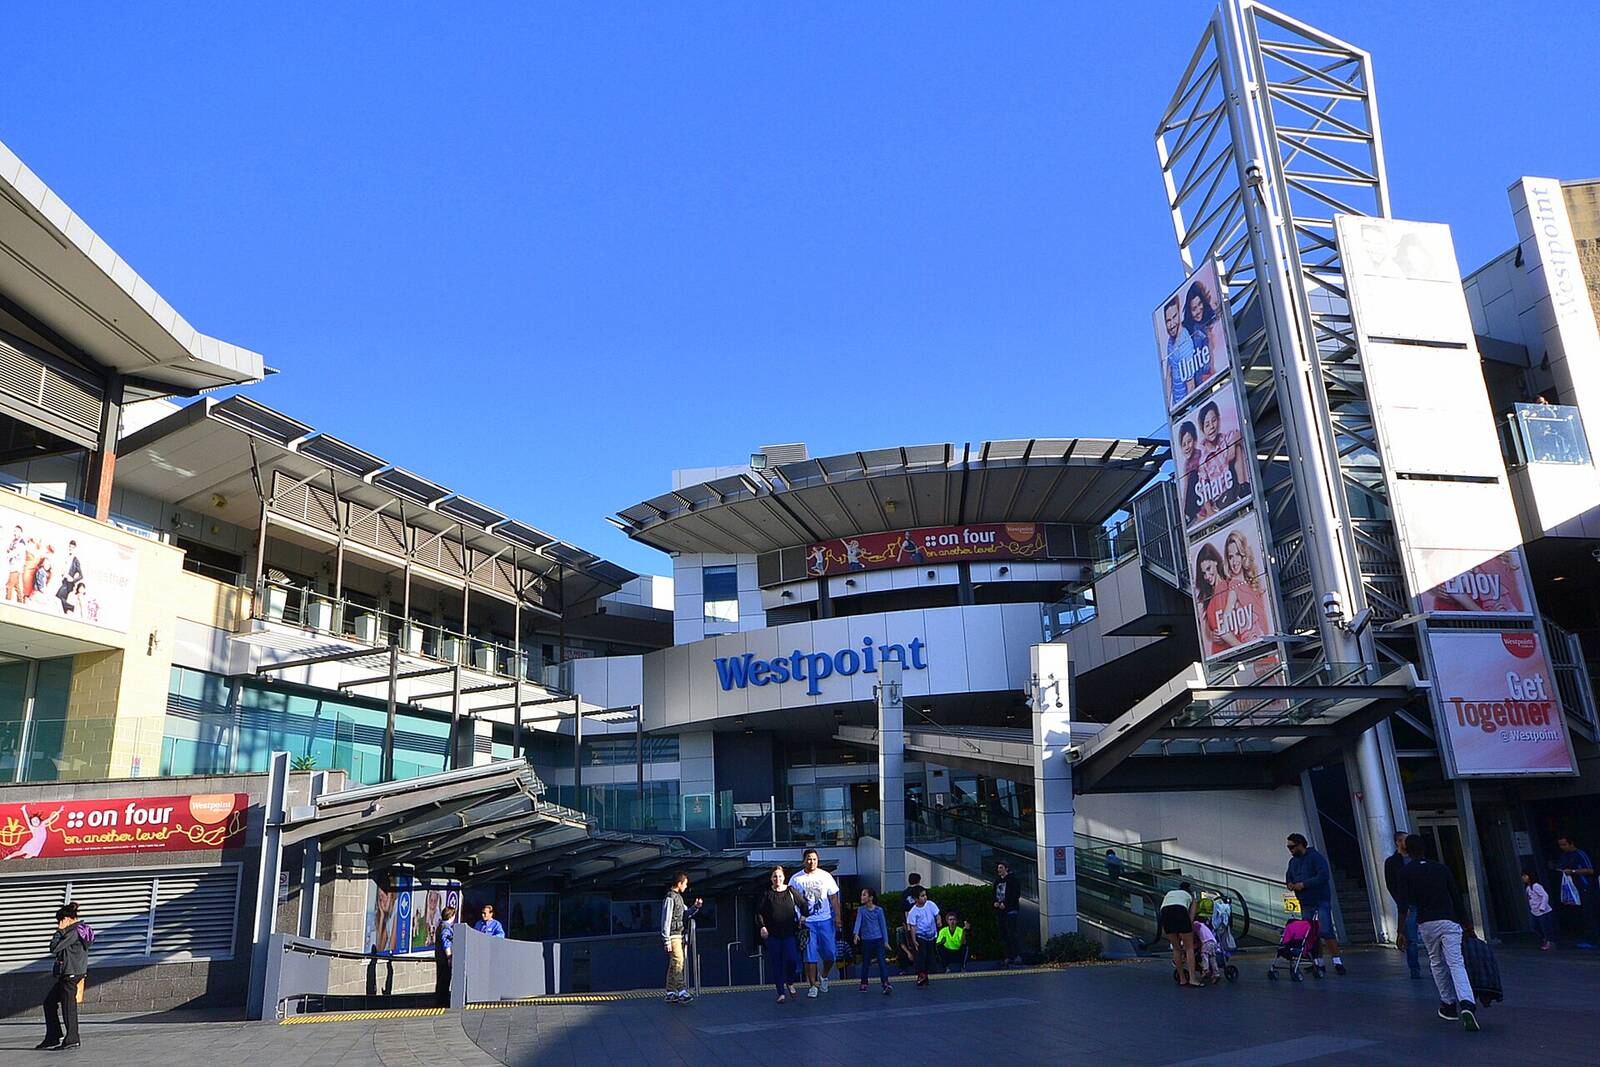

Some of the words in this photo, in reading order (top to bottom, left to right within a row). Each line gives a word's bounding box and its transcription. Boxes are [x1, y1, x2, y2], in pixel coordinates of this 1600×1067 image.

[1178, 345, 1211, 383] Unite
[1194, 469, 1234, 506] Share
[926, 549, 937, 558] on
[939, 545, 973, 557] another
[973, 544, 997, 554] level
[938, 533, 959, 546] on
[963, 528, 996, 544] four
[1445, 570, 1500, 600] Enjoy
[1215, 603, 1254, 636] Enjoy
[713, 636, 928, 696] Westpoint
[1505, 671, 1548, 701] Get
[1450, 697, 1552, 733] Together
[1511, 730, 1559, 743] Westpoint
[87, 809, 118, 827] on
[124, 802, 174, 826] four
[64, 834, 82, 845] on
[83, 828, 134, 844] another
[135, 826, 169, 842] level
